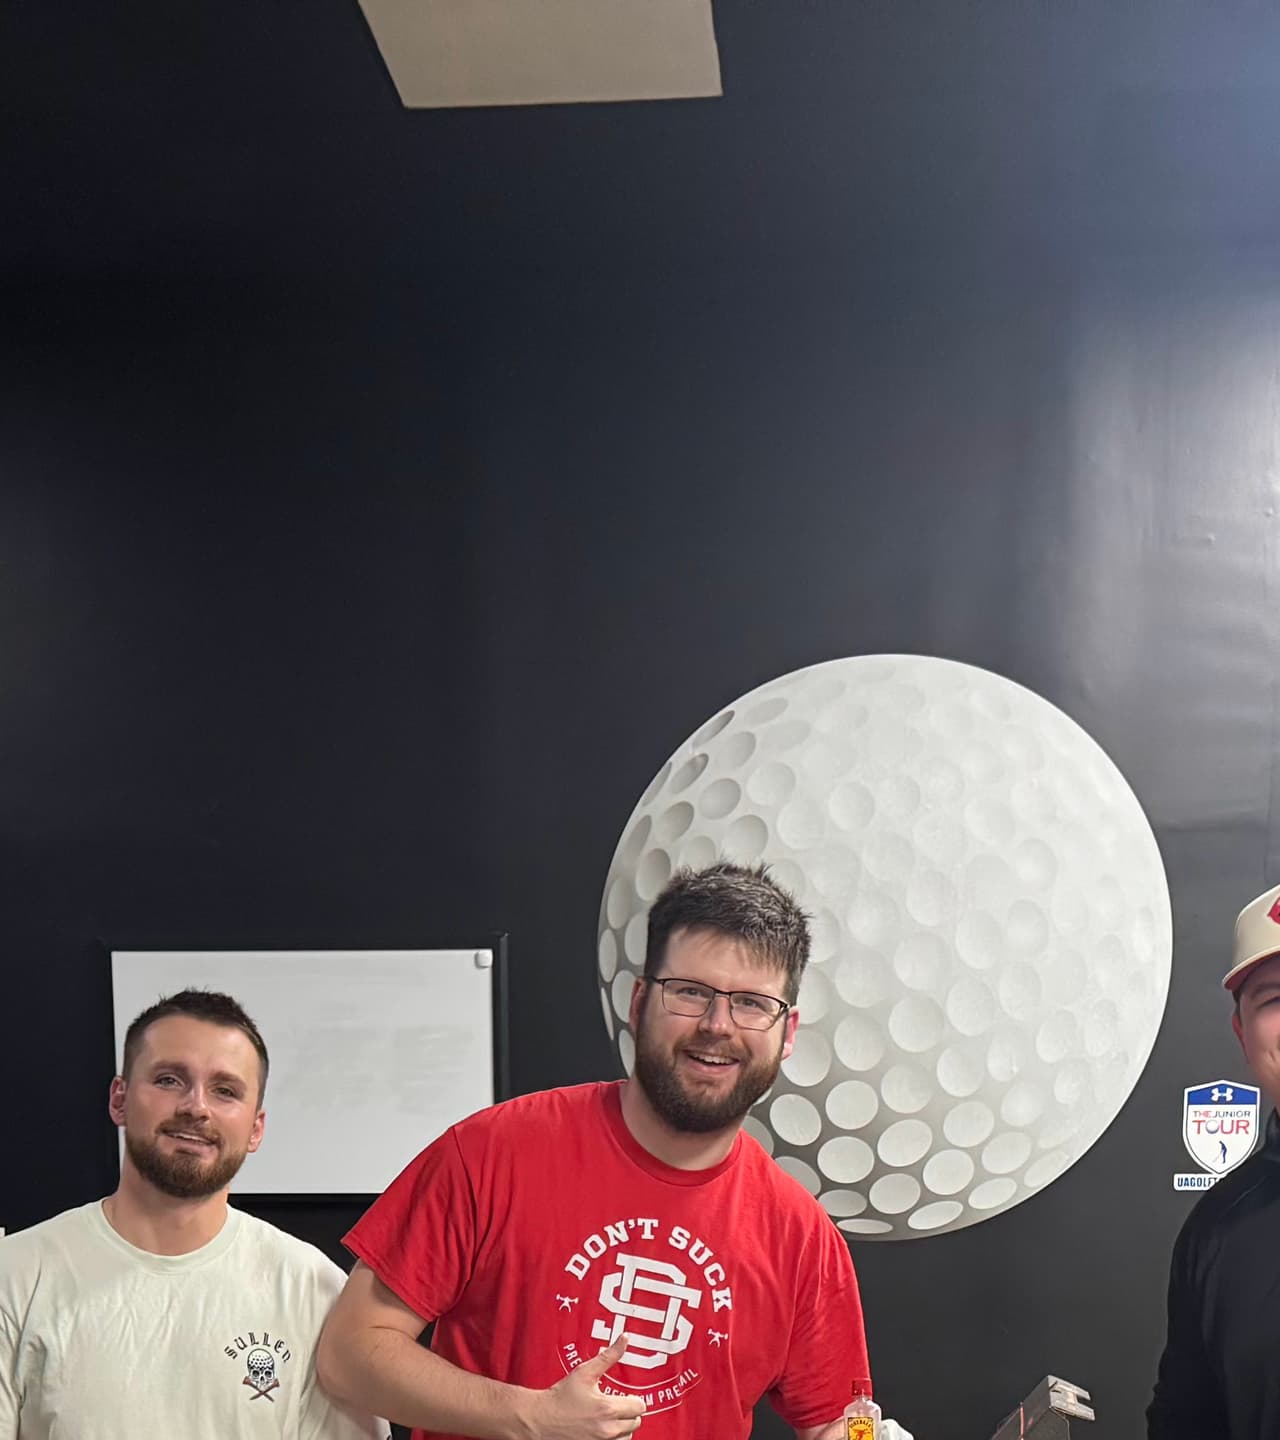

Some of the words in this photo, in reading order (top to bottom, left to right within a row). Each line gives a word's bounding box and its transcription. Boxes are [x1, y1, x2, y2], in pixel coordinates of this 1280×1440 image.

[1192, 1119, 1250, 1135] TOUR
[1193, 1110, 1211, 1118] THE
[1212, 1110, 1251, 1118] JUNIOR
[564, 1217, 659, 1281] DON'T
[668, 1225, 733, 1313] SUCK
[658, 1368, 699, 1404] PREAIL
